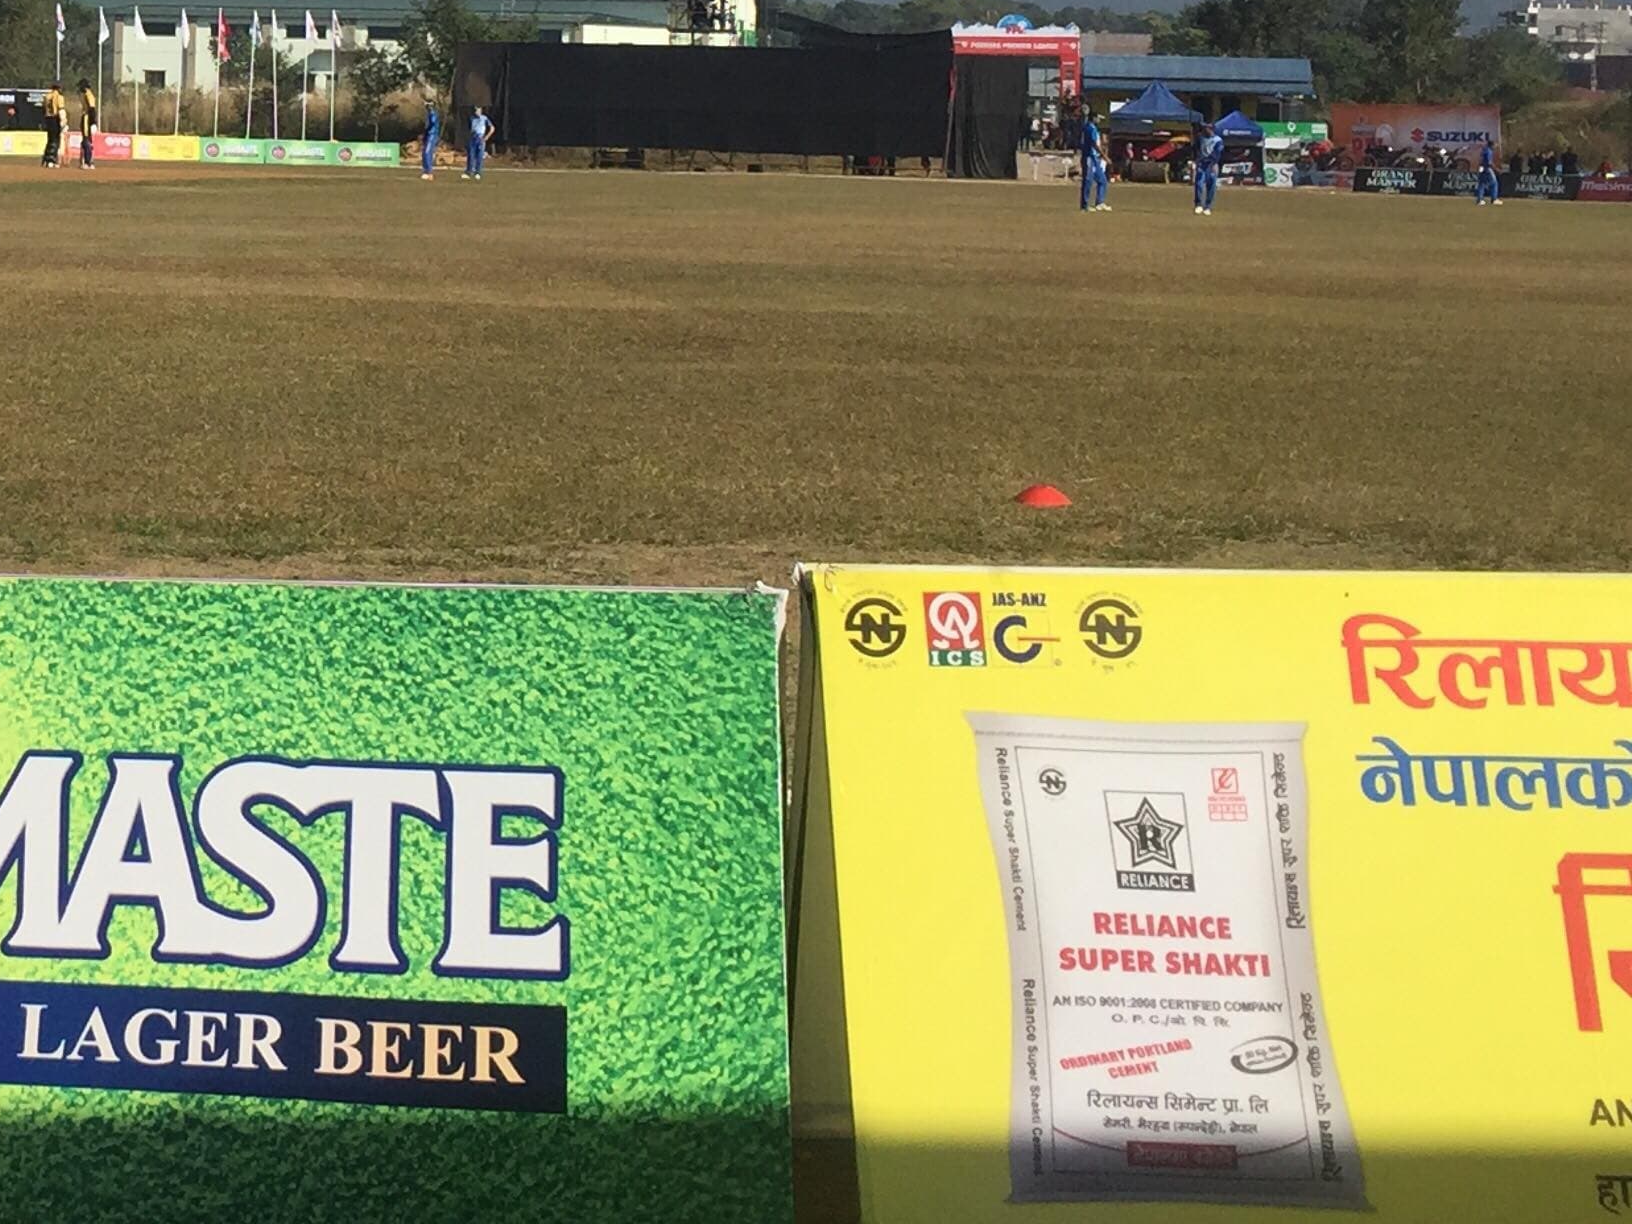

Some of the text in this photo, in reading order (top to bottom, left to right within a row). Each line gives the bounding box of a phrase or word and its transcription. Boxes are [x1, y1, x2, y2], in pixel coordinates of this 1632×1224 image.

[1426, 130, 1492, 144] SUZUKI
[1366, 176, 1418, 190] MASTER
[1371, 169, 1414, 180] GRAND
[1519, 174, 1563, 186] GRAND
[1515, 181, 1566, 194] MASTER
[931, 651, 985, 666] ICS
[995, 747, 1027, 932] Reliance Super Shakti Cement
[1120, 872, 1190, 890] RELIANCE
[1092, 911, 1233, 940] RELIANCE
[1058, 947, 1271, 977] SUPER SHAKTI
[1022, 978, 1037, 1042] Reliance
[1052, 995, 1071, 1007] AN
[1074, 995, 1097, 1007] ISO
[1159, 999, 1222, 1012] CERTIFIED
[1223, 1001, 1284, 1013] COMPANY
[17, 1002, 287, 1071] LAGER
[313, 1016, 526, 1084] BEER
[1026, 1044, 1039, 1081] Super
[1059, 1038, 1194, 1071] ORDINARY PORTLAND
[1107, 1060, 1160, 1080] CEMENT
[1029, 1084, 1042, 1124] Shakti
[1086, 1089, 1159, 1111] रिलायन्स
[1164, 1092, 1218, 1113] सिमेन्ट
